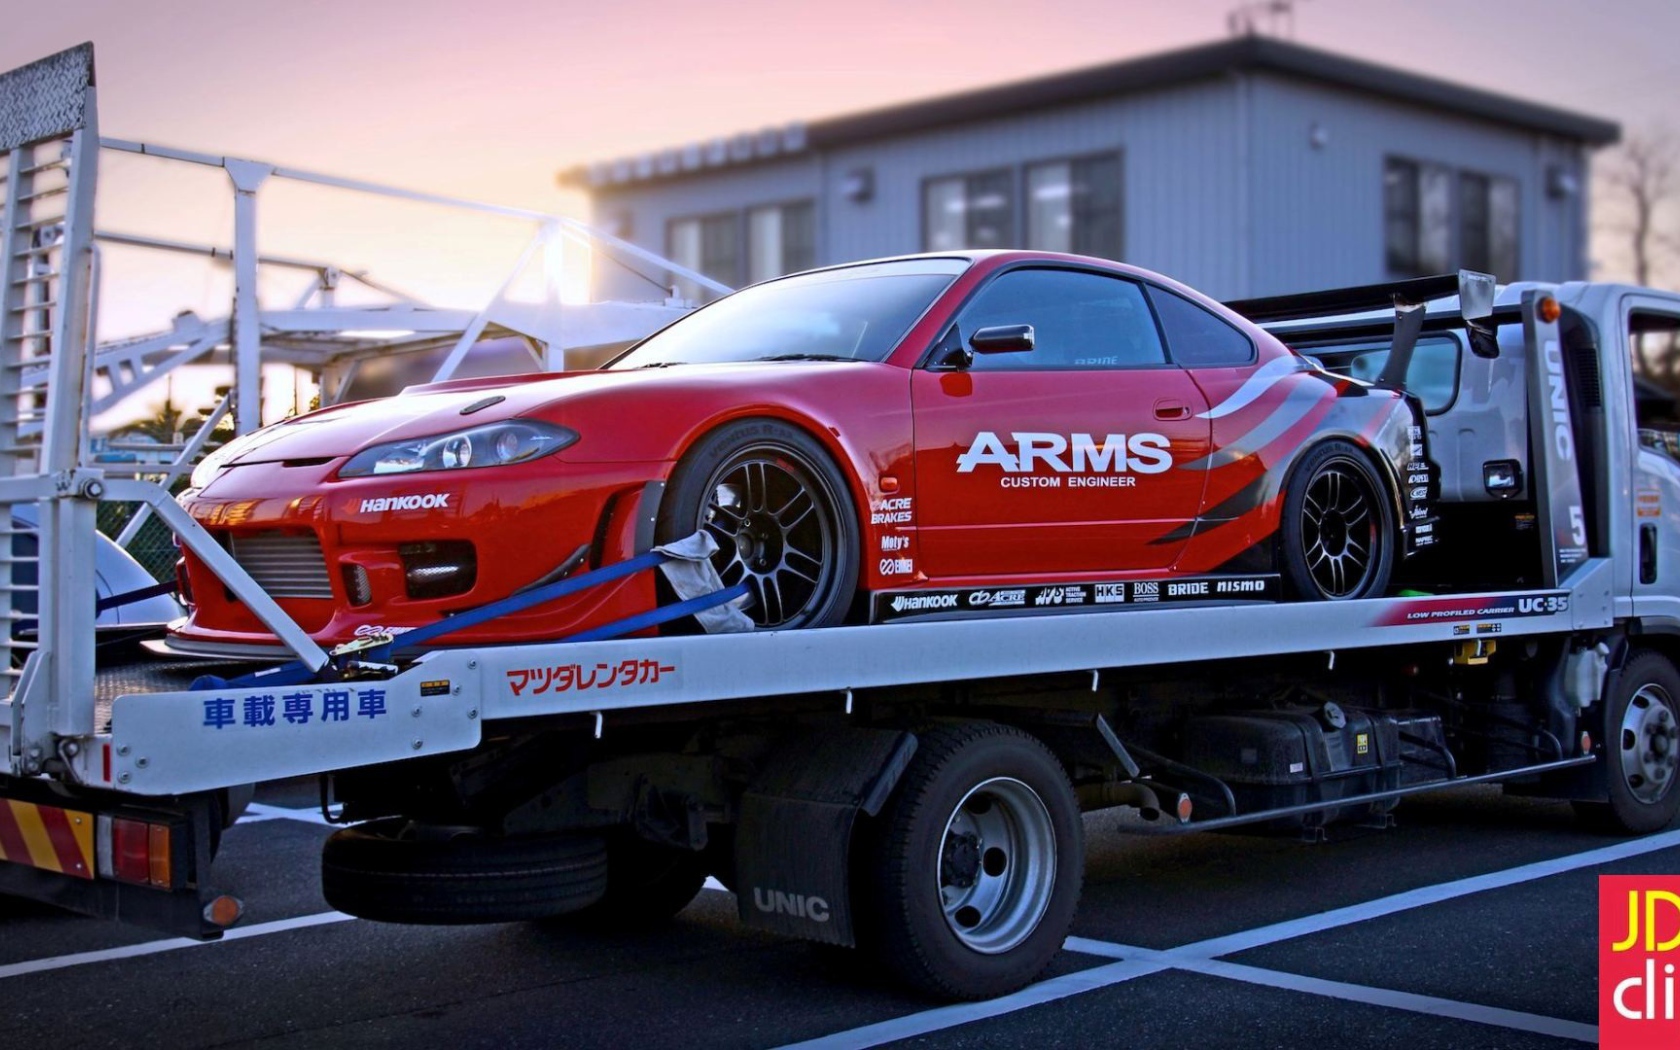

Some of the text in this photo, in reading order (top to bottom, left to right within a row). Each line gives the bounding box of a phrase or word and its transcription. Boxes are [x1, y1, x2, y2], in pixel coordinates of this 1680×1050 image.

[1544, 340, 1572, 460] UNIC
[956, 431, 1173, 474] ARMS
[1001, 476, 1136, 488] CUSTOM ENGINEER
[880, 498, 912, 511] ACRE
[871, 511, 912, 524] BRAKES
[1095, 584, 1124, 598] HKS
[1134, 582, 1159, 595] BOSS
[1168, 582, 1209, 596] BRIDE
[1431, 609, 1475, 618] PROFILED
[1477, 606, 1515, 615] CARRIER
[507, 659, 675, 696] マツダレンタカー
[203, 689, 387, 730] 車載専用車
[753, 887, 830, 922] UNIC
